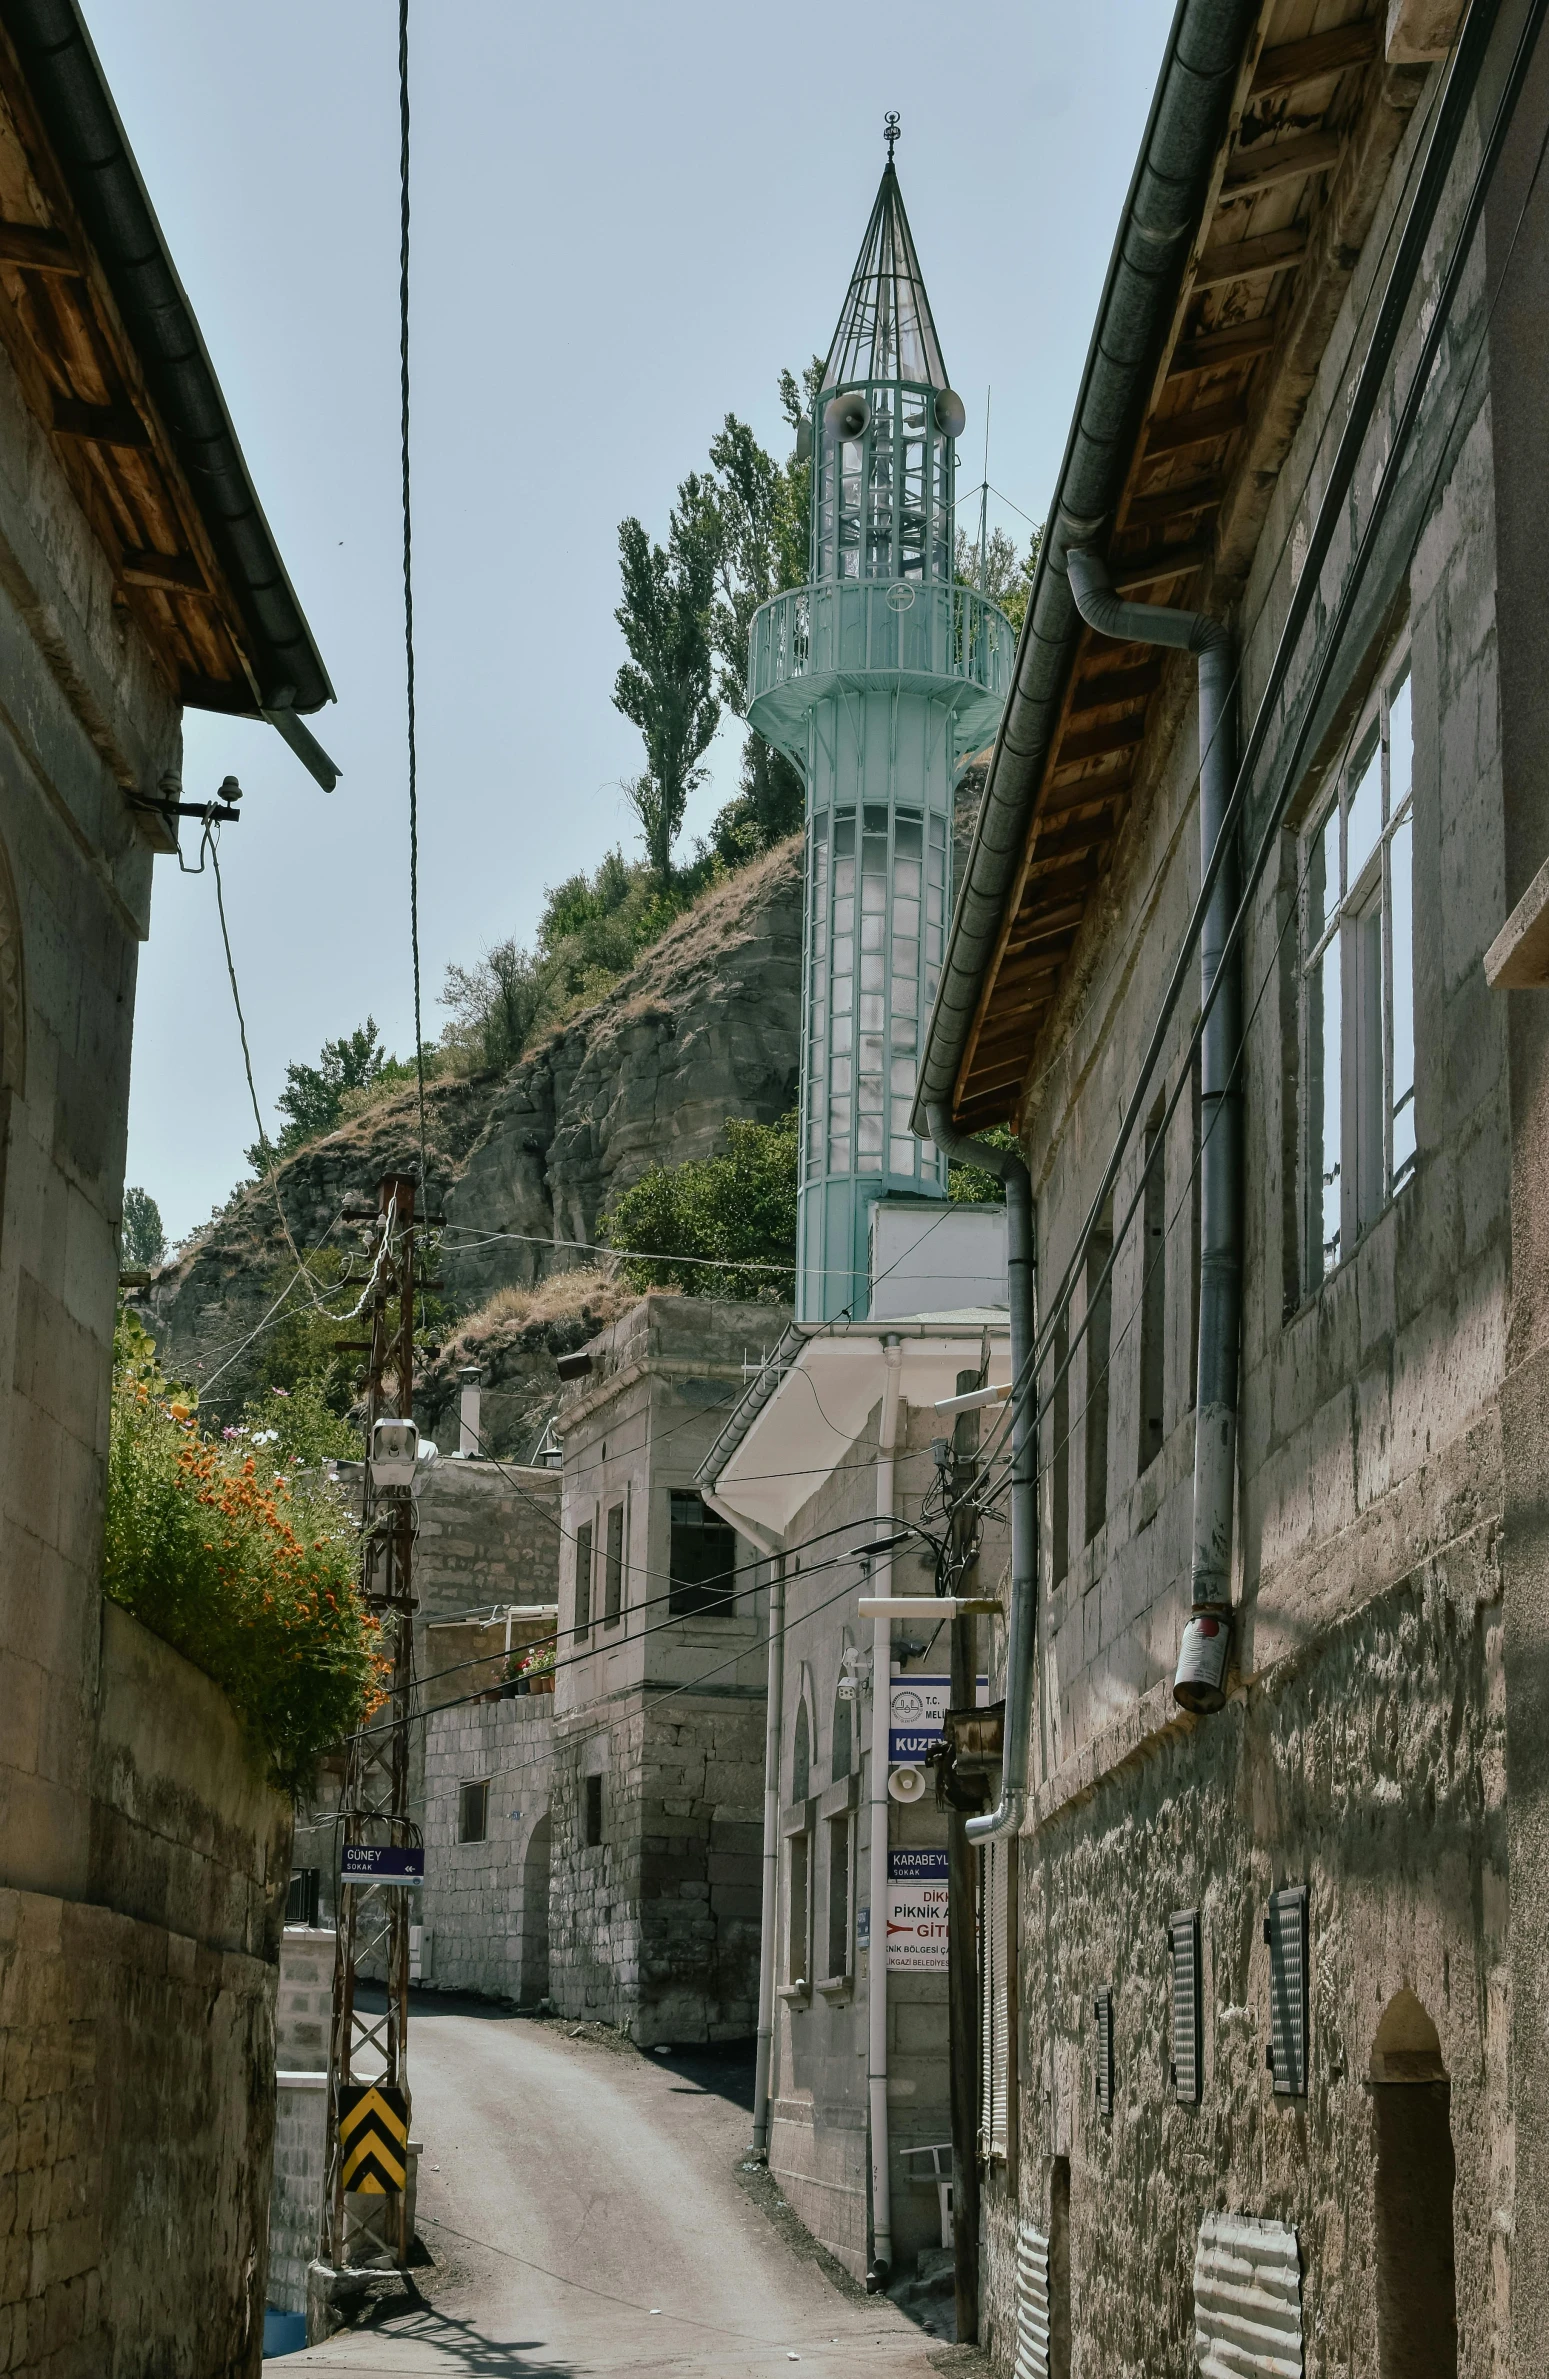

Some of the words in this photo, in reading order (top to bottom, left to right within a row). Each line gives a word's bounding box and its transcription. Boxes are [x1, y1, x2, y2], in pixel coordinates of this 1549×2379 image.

[925, 1696, 940, 1705] T.C.
[347, 1849, 382, 1861] GÜNEY
[893, 1854, 949, 1866] KARABEYL
[346, 1863, 372, 1871] SOKAK
[894, 1904, 940, 1919] PİKNİK
[916, 1922, 949, 1938] GİT
[904, 1944, 939, 1954] BÖLGESİ
